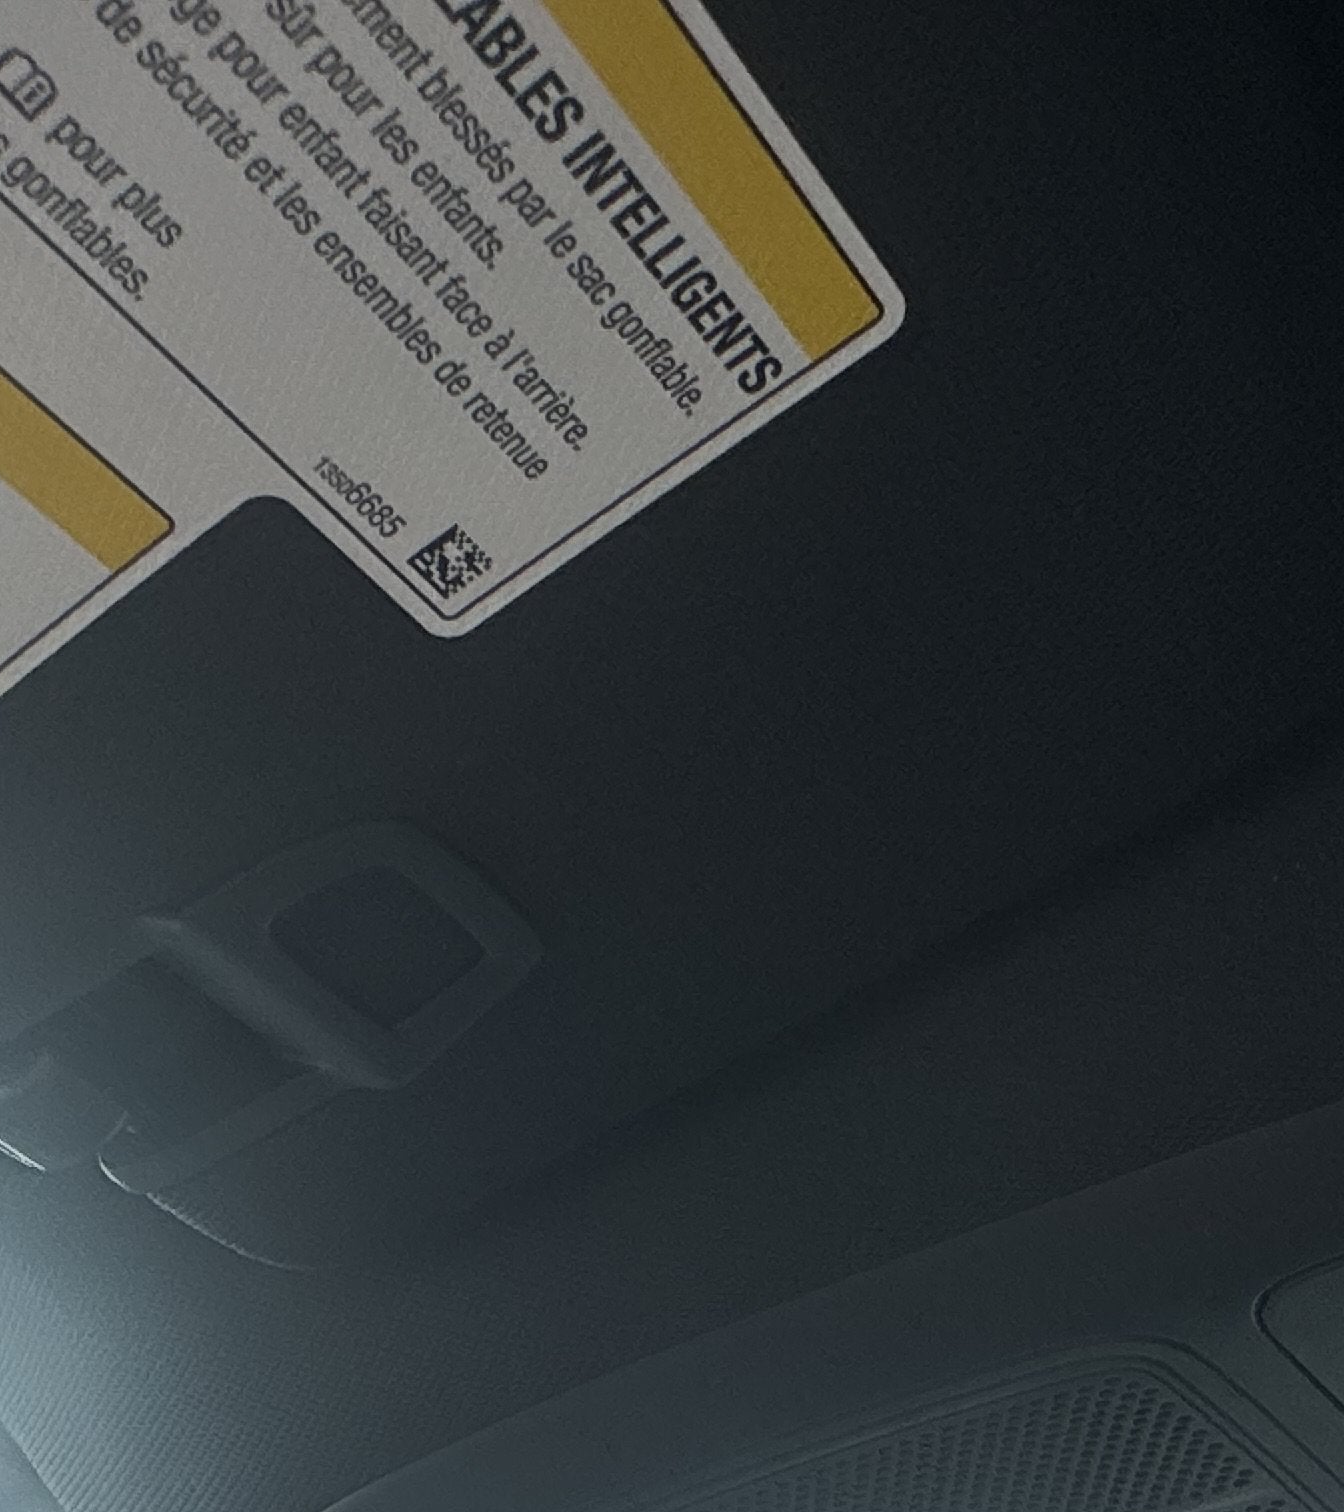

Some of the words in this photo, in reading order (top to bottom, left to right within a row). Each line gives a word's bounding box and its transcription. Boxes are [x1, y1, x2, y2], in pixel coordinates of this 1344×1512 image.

[0, 153, 149, 303] gonflables.
[44, 114, 127, 188] pour
[112, 181, 183, 250] plus
[96, 0, 142, 44] de
[136, 39, 257, 161] sécurité
[244, 154, 287, 197] et
[273, 181, 323, 237] les
[313, 230, 442, 366] ensembles
[434, 359, 470, 398] de
[462, 391, 552, 482] retenue
[207, 30, 291, 105] pour
[278, 101, 371, 200] enfant
[357, 187, 448, 288] faisant
[435, 274, 493, 339] face
[484, 328, 514, 362] à
[501, 347, 589, 453] l'arrière.
[304, 44, 385, 121] pour
[371, 106, 420, 166] les
[410, 161, 504, 271] enfants.
[341, 0, 434, 82] ment
[417, 67, 515, 184] blessés
[498, 176, 557, 229] par
[544, 219, 578, 260] le
[566, 250, 617, 307] sac
[599, 298, 705, 416] gonflable.
[561, 129, 784, 395] INTELLIGENTS
